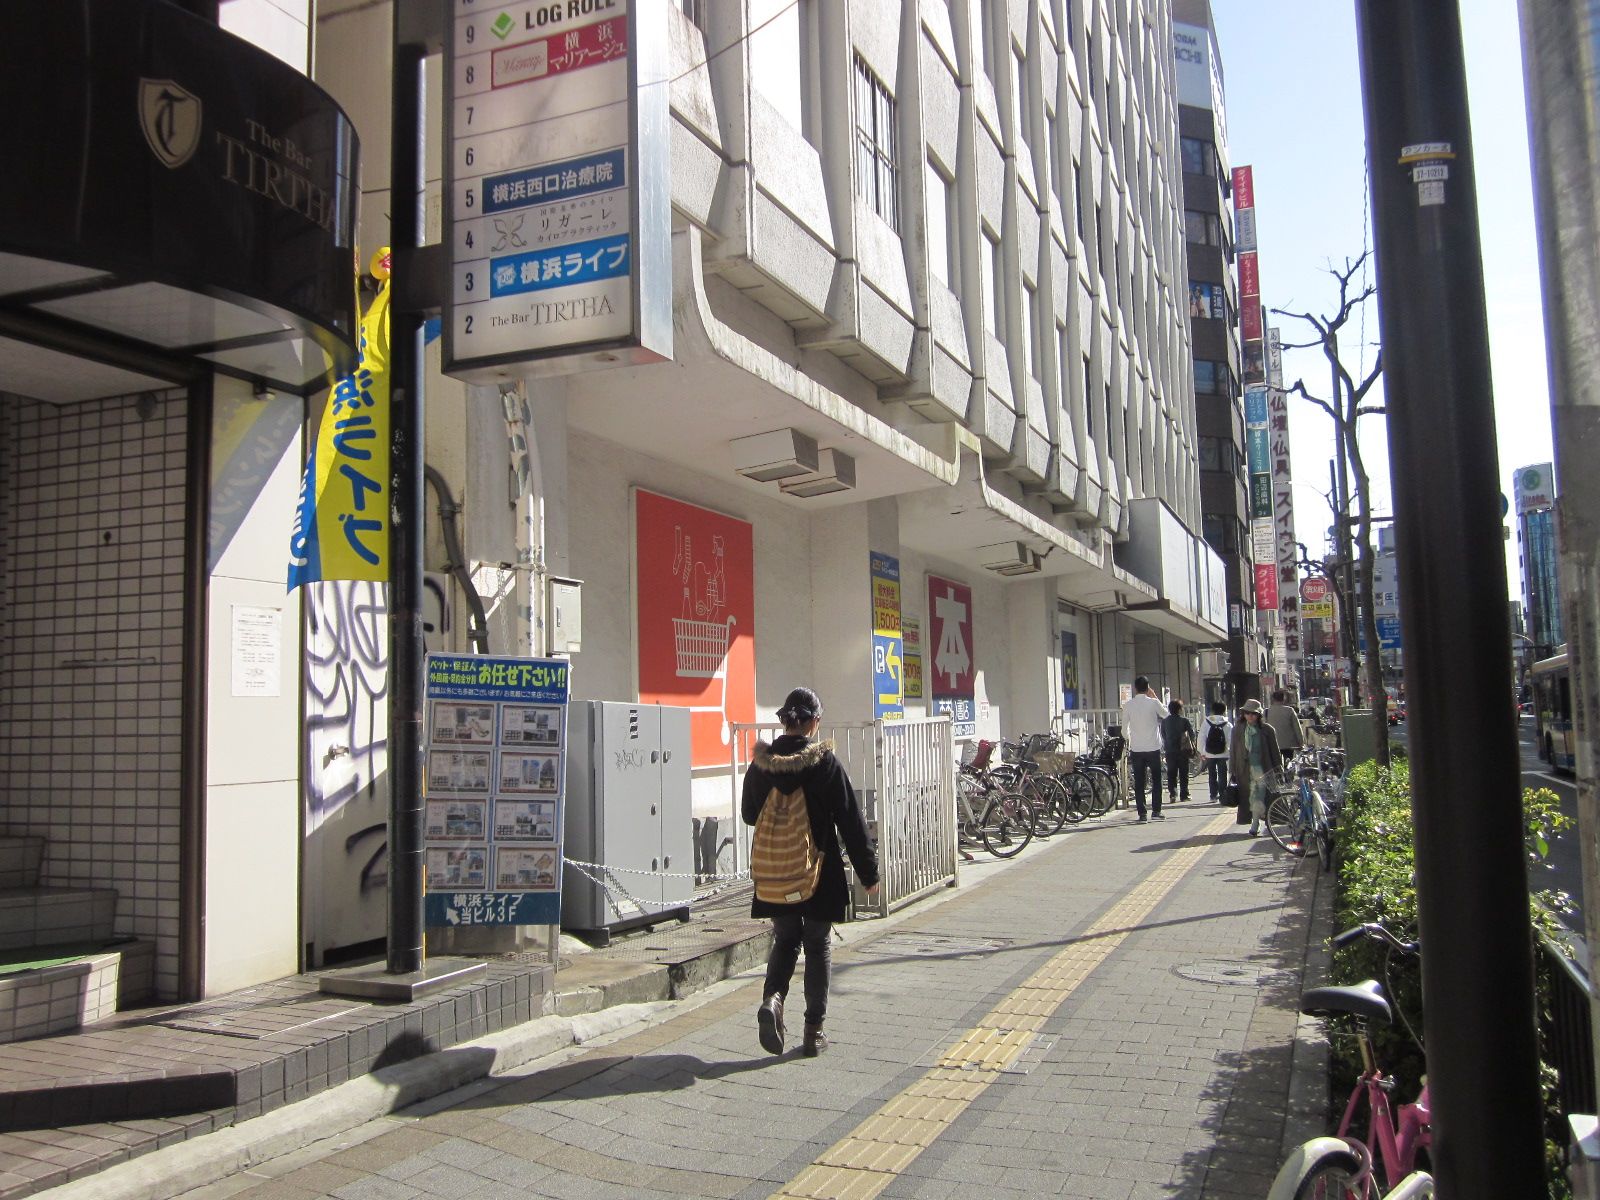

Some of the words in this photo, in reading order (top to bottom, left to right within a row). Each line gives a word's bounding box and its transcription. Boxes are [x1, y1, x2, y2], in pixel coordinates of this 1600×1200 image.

[465, 25, 475, 43] 9
[525, 7, 561, 30] LOG
[564, 21, 614, 50] 横浜
[549, 40, 626, 70] マリアージュ
[465, 66, 475, 84] 8
[465, 107, 475, 125] 7
[246, 118, 282, 149] The
[285, 136, 313, 169] Bar
[465, 148, 474, 165] 6
[465, 189, 474, 207] 5
[492, 162, 613, 203] 横浜西口治療院
[465, 230, 474, 249] 4
[542, 208, 613, 231] リガーレ
[465, 272, 474, 291] 3
[520, 243, 628, 284] 横浜ライブ
[465, 315, 473, 334] 2
[490, 315, 510, 327] The
[511, 312, 530, 325] Bar
[531, 295, 615, 326] TIRTHA
[1270, 395, 1290, 477] 仏壇・仏具
[1281, 596, 1300, 651] 横浜店
[478, 663, 566, 688] お任せ下さい!!
[453, 893, 524, 908] 横浜ライブ
[461, 905, 518, 925] 当ビル3F
